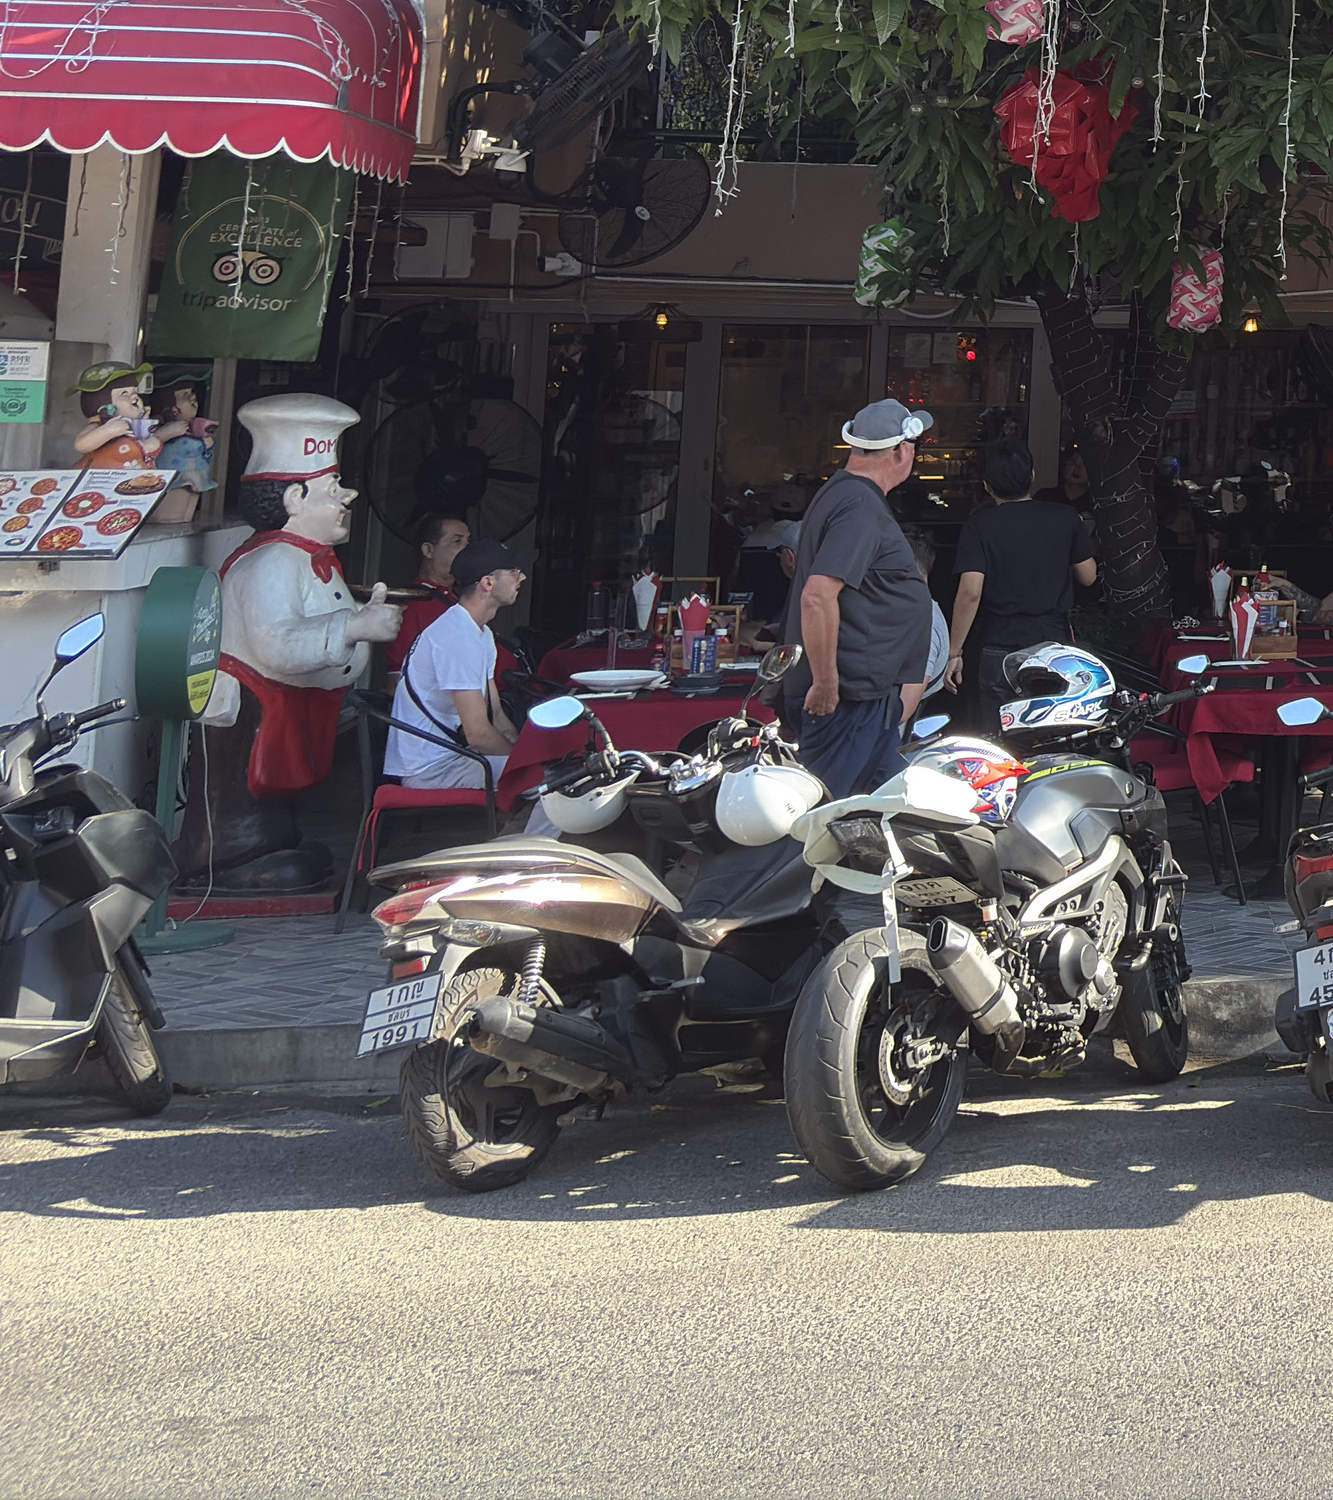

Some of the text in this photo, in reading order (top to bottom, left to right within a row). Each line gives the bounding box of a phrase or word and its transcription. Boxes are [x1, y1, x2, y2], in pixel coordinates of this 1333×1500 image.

[182, 291, 293, 311] tripadvisor
[1054, 700, 1103, 722] SHARK
[921, 896, 956, 905] 207
[372, 1021, 419, 1050] 1991
